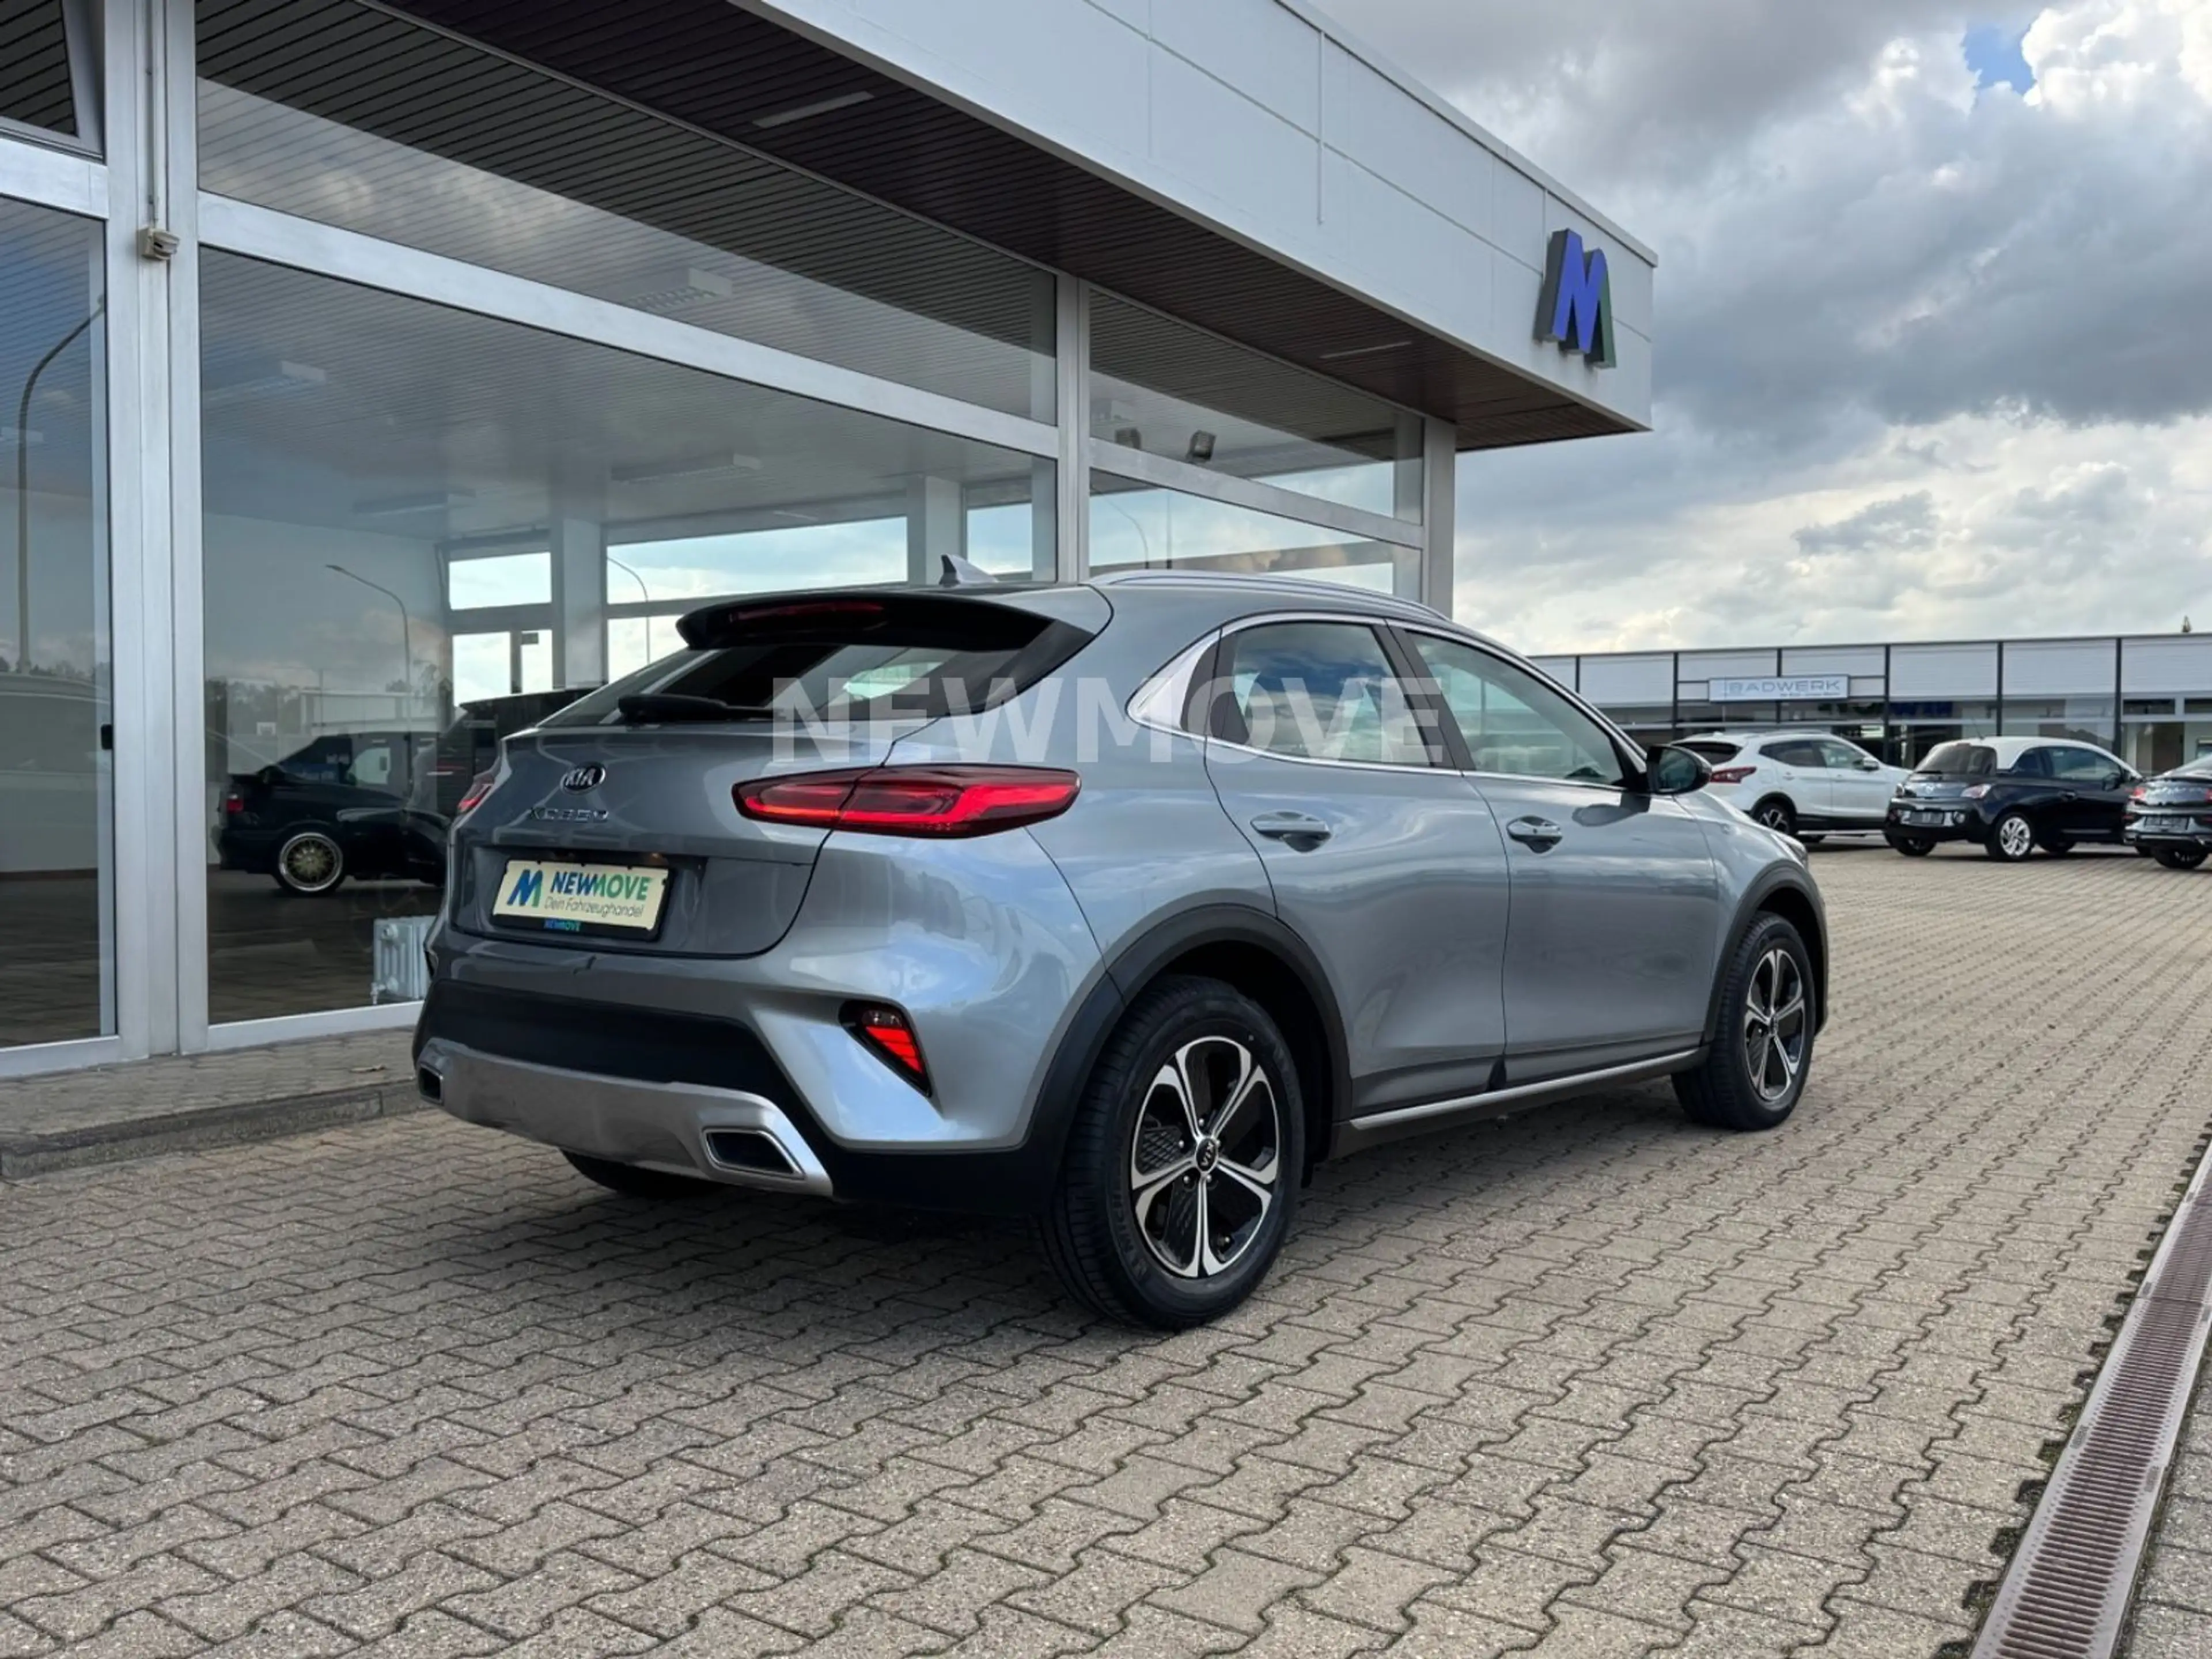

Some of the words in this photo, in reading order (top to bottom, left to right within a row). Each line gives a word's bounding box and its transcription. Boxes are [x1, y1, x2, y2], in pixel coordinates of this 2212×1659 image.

[1535, 228, 1616, 369] M
[565, 768, 596, 786] KIA
[531, 808, 609, 823] XCEED
[506, 869, 543, 908] M
[550, 871, 652, 900] NEWMOVE
[544, 896, 565, 911] Dein
[565, 897, 645, 918] Fahrzeughandel
